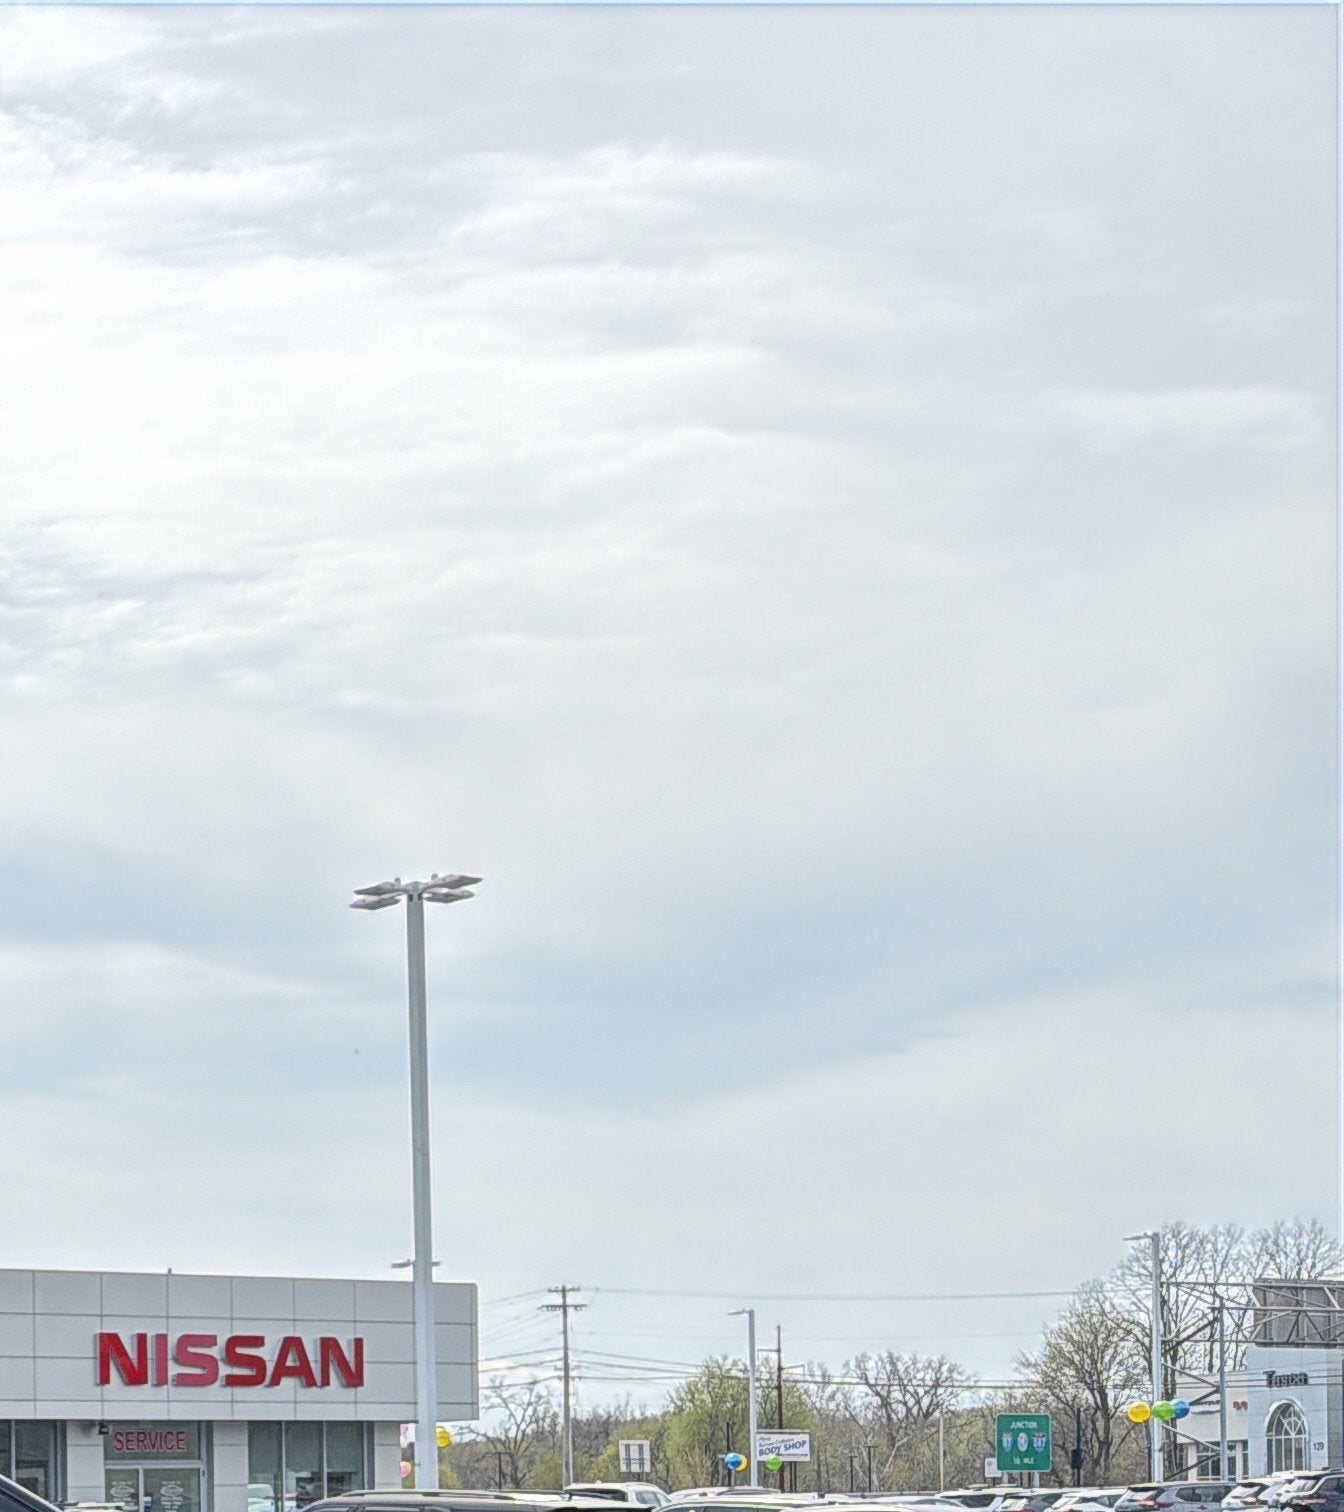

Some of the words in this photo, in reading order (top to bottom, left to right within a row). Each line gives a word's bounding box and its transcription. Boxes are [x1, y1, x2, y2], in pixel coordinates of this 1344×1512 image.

[96, 1332, 365, 1388] NISSAN
[113, 1430, 187, 1453] SERVICE
[758, 1445, 782, 1457] BODY
[783, 1439, 807, 1452] SHOP
